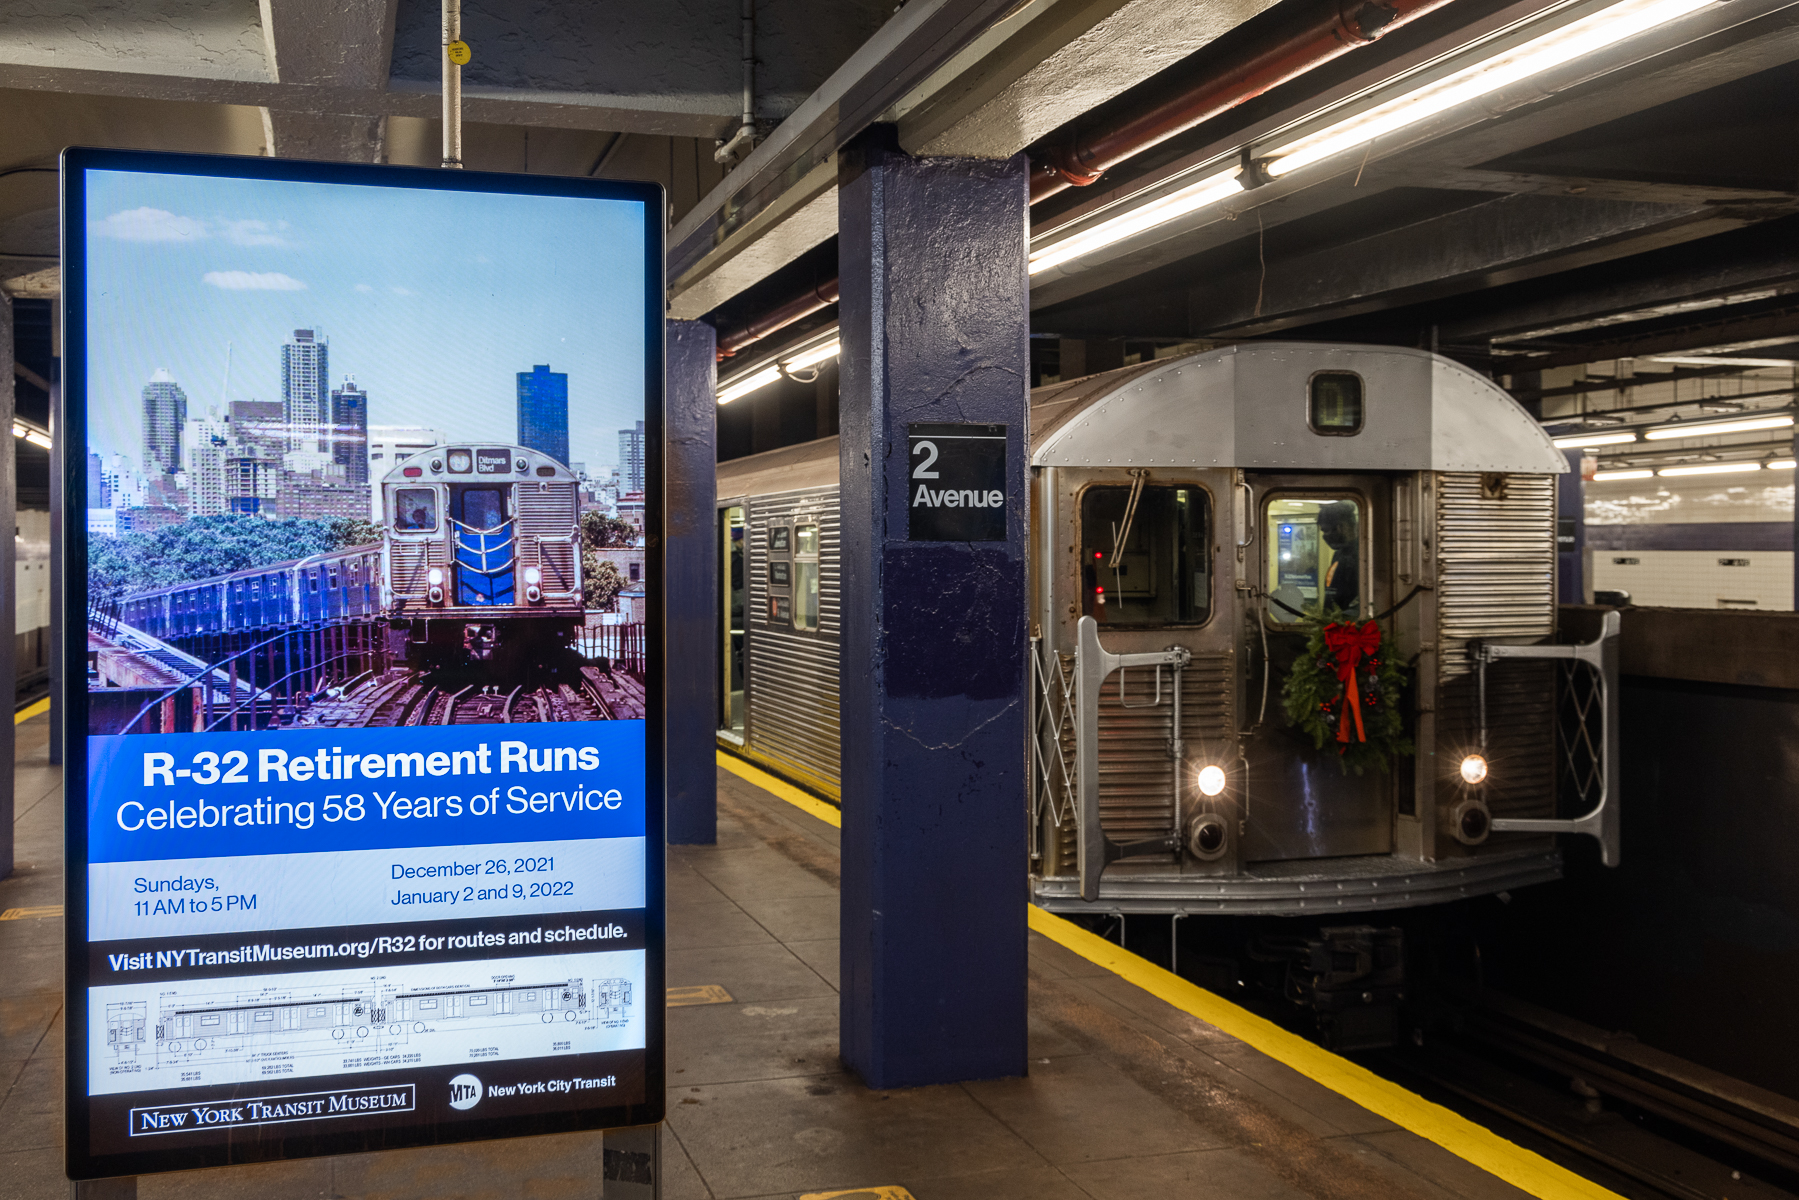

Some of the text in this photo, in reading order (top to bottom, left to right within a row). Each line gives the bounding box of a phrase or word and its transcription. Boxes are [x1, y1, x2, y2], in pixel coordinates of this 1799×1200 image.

[478, 456, 507, 465] Ditmars
[478, 464, 495, 472] Blvd
[912, 440, 939, 479] 2
[912, 484, 1004, 508] Avenue
[143, 741, 600, 787] R-32 Retirement Runs
[116, 783, 623, 832] Celebrating 58 Years of Service
[391, 856, 555, 880] December 26, 2021
[133, 875, 219, 894] Sundays,
[390, 880, 574, 906] January 2 and 9, 2022
[134, 893, 257, 917] 11 AM to 5 PM
[108, 922, 628, 972] Visit NYTransitMuseum.org/R32 for routes and schedule.
[450, 1083, 477, 1104] MTA
[488, 1075, 616, 1098] New York City Transit
[141, 1092, 407, 1130] NEW YORK TRANSIT MUSEUM
